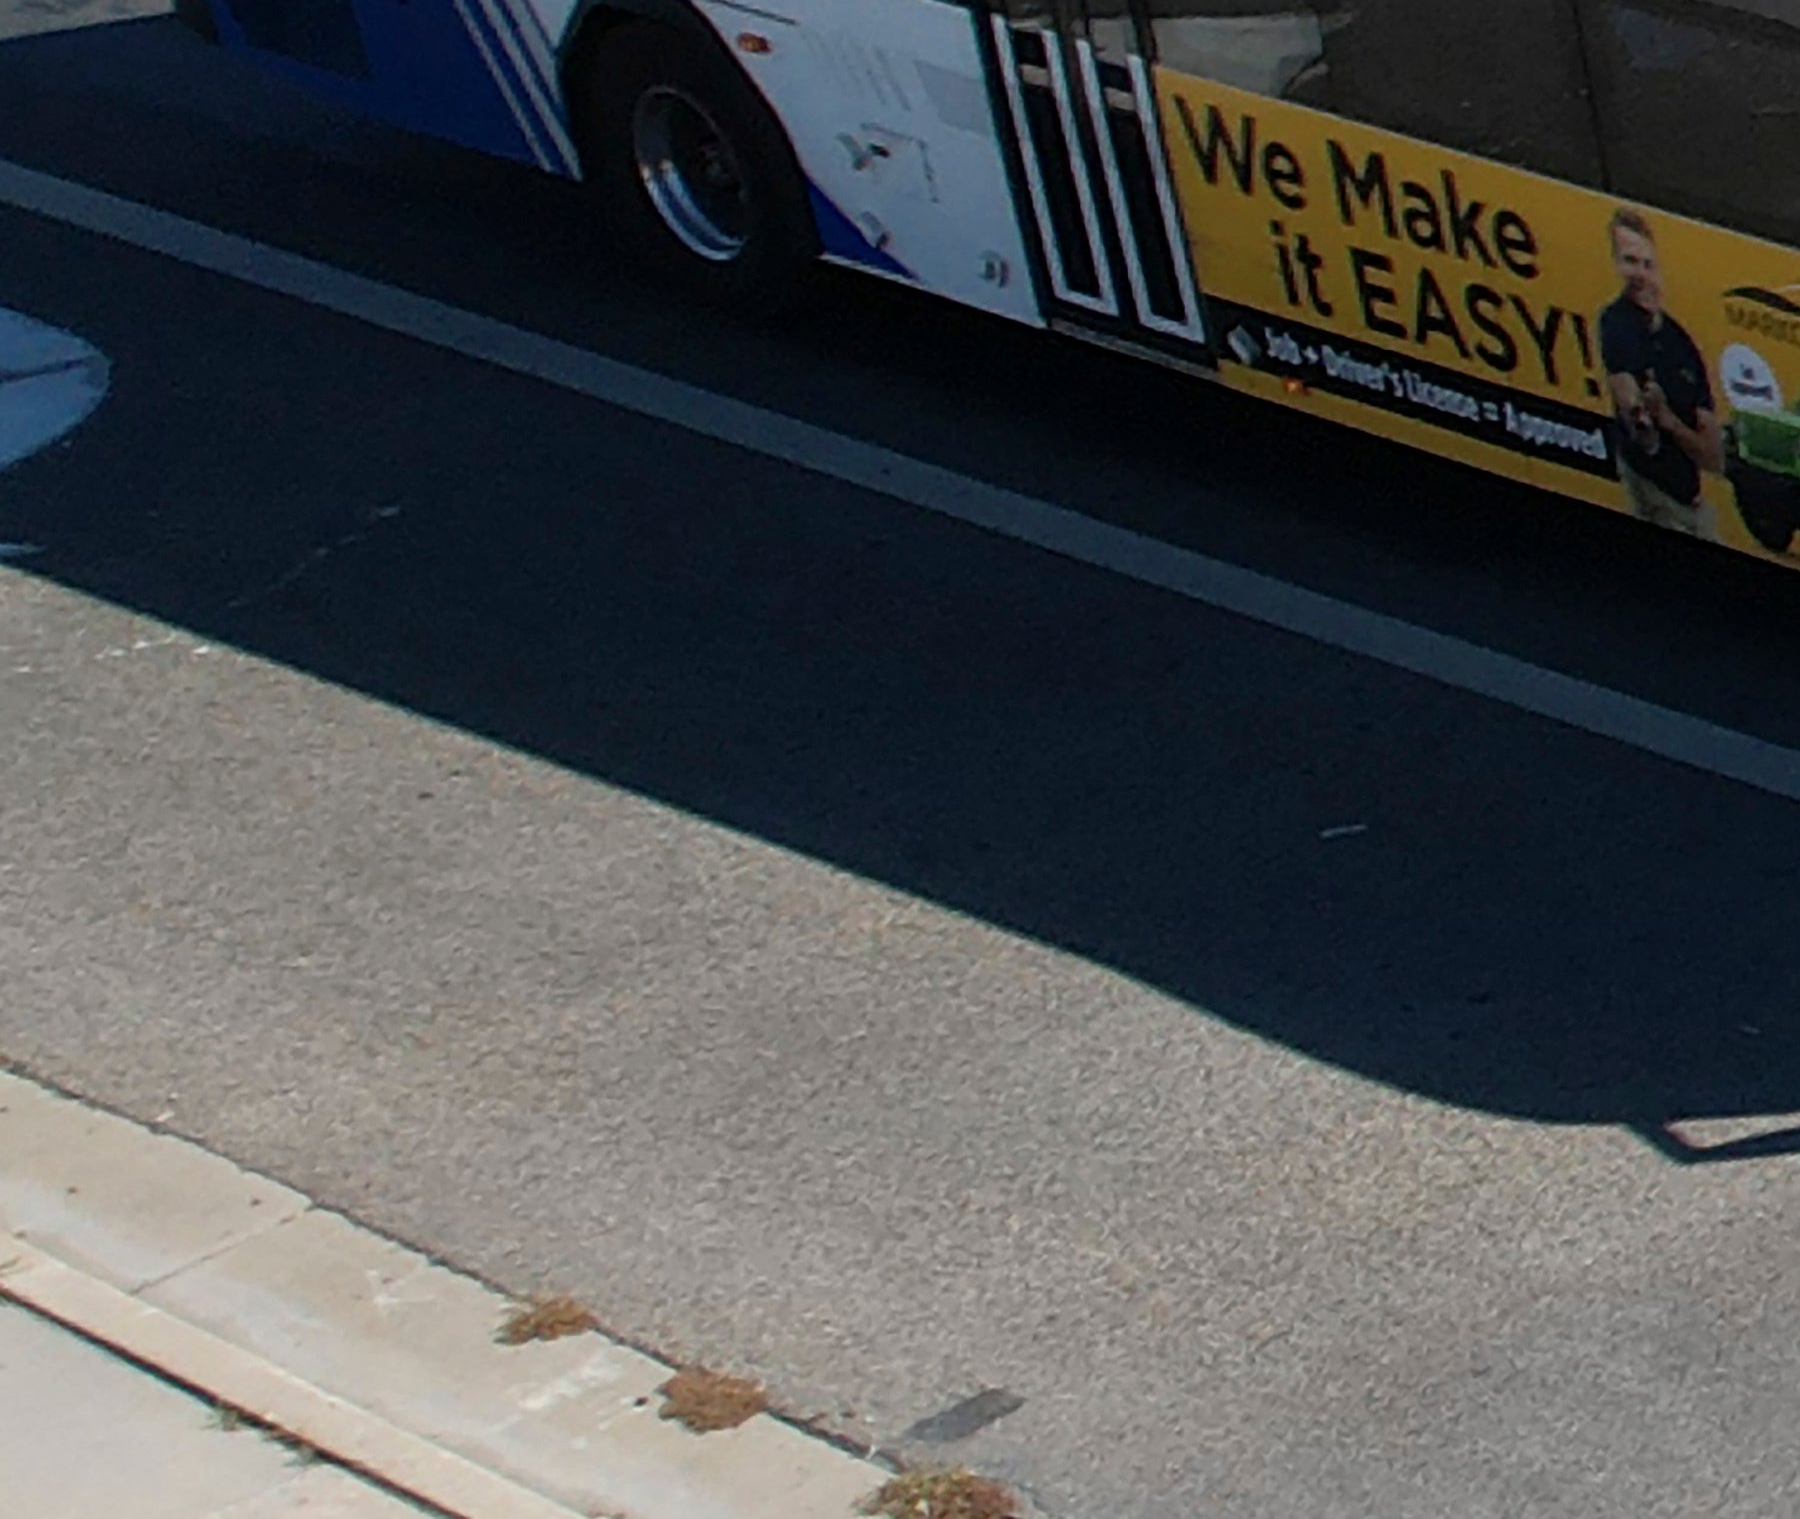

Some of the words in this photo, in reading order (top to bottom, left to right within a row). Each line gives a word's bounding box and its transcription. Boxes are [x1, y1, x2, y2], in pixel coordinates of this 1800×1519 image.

[1173, 93, 1307, 210] We
[1326, 138, 1540, 279] Make
[1263, 325, 1303, 366] Job
[1320, 343, 1403, 398] Driver's
[1402, 367, 1480, 423] License
[1502, 401, 1608, 461] Approved
[1269, 219, 1333, 318] it
[1348, 245, 1602, 397] EASY!
